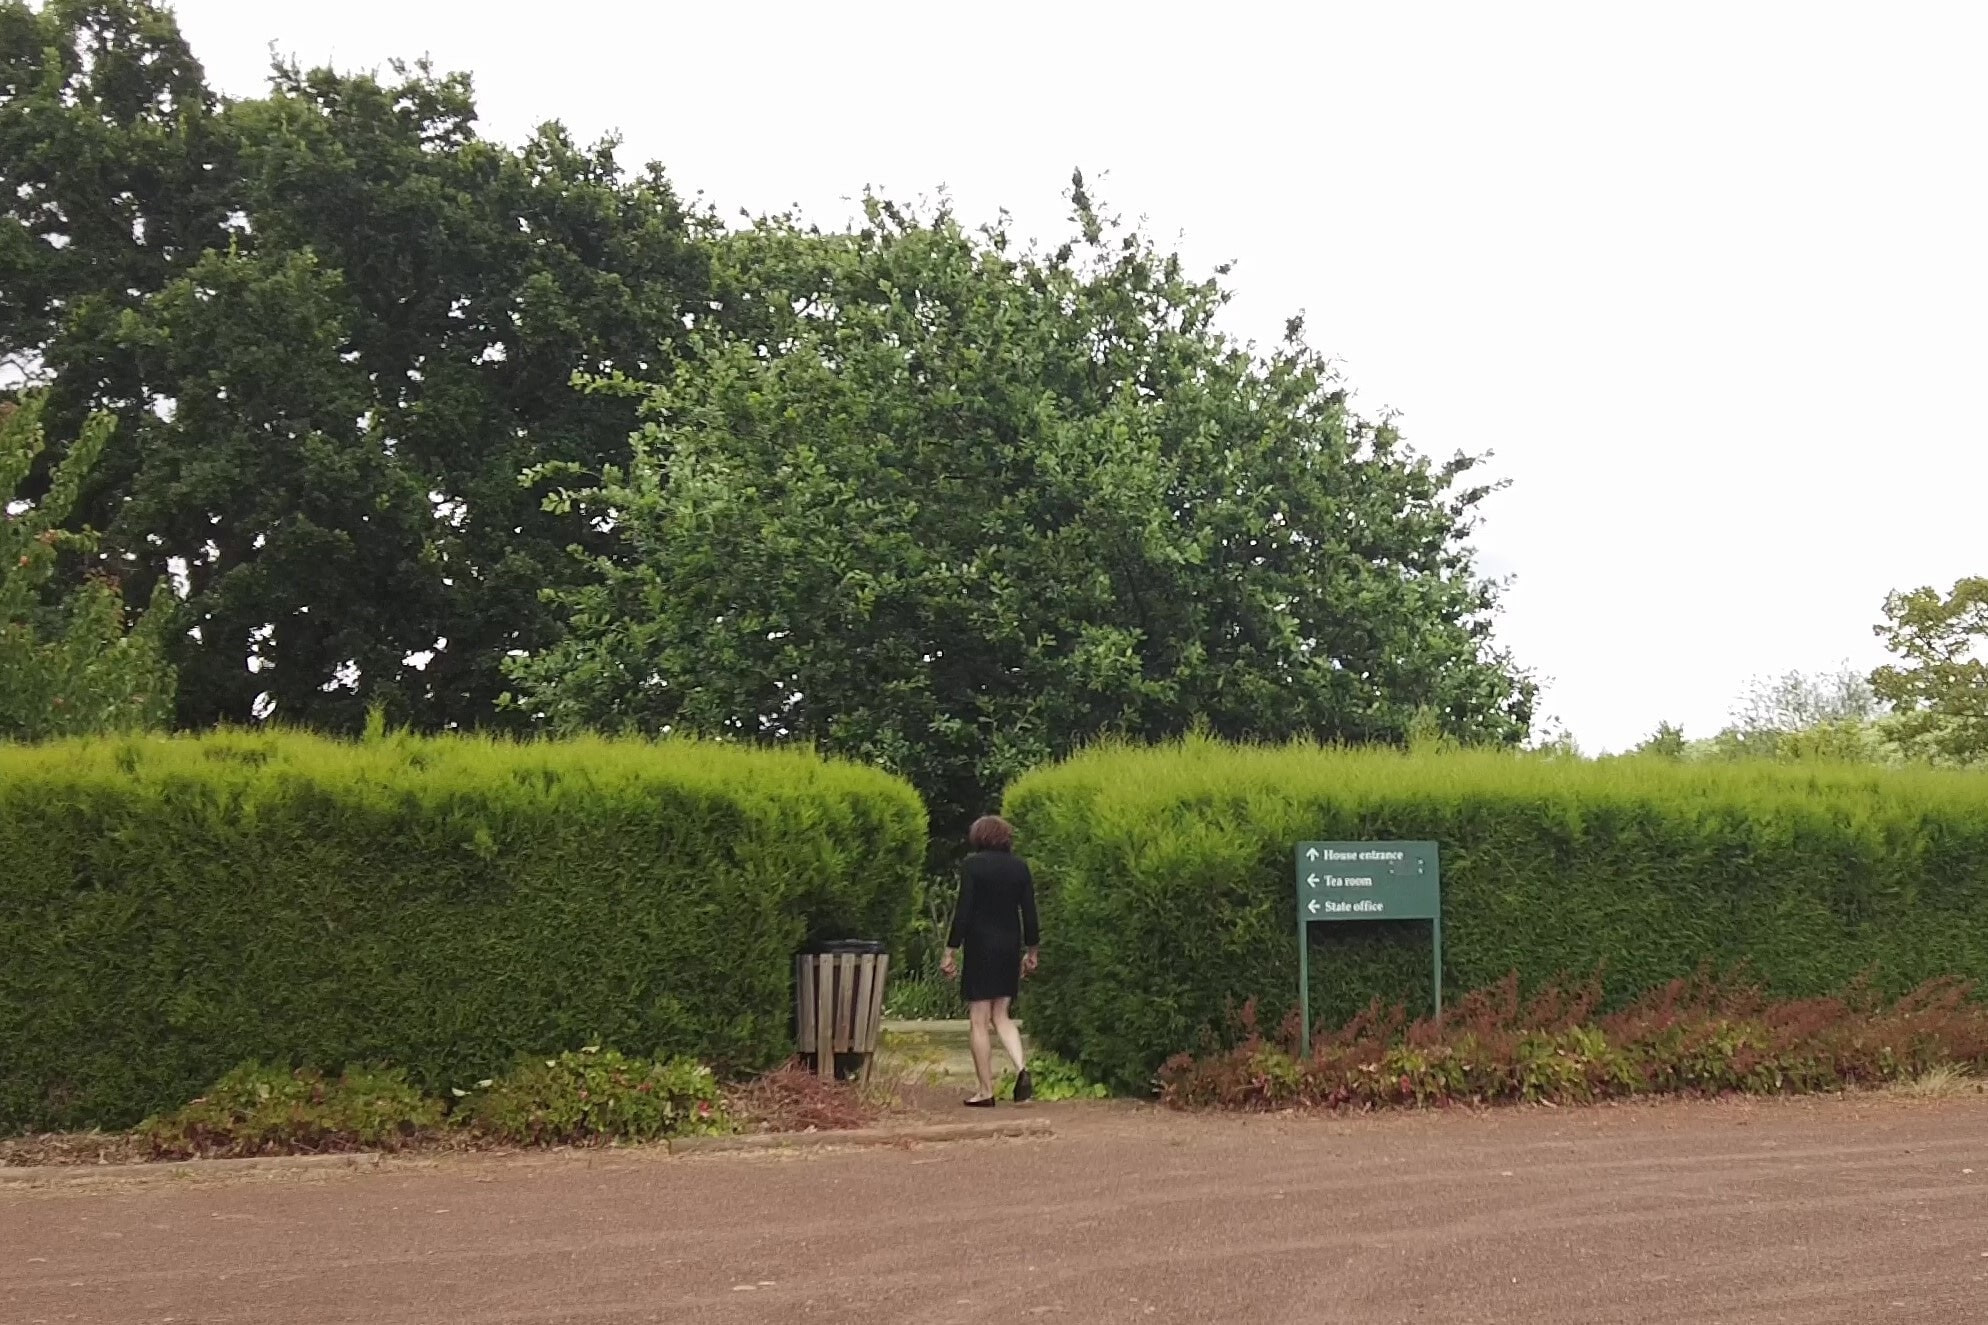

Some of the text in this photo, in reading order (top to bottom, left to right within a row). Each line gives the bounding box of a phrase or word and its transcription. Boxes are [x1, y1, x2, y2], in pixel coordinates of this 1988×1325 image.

[1323, 849, 1404, 861] House entrance
[1323, 874, 1373, 887] Tea room
[1324, 900, 1384, 912] State office
